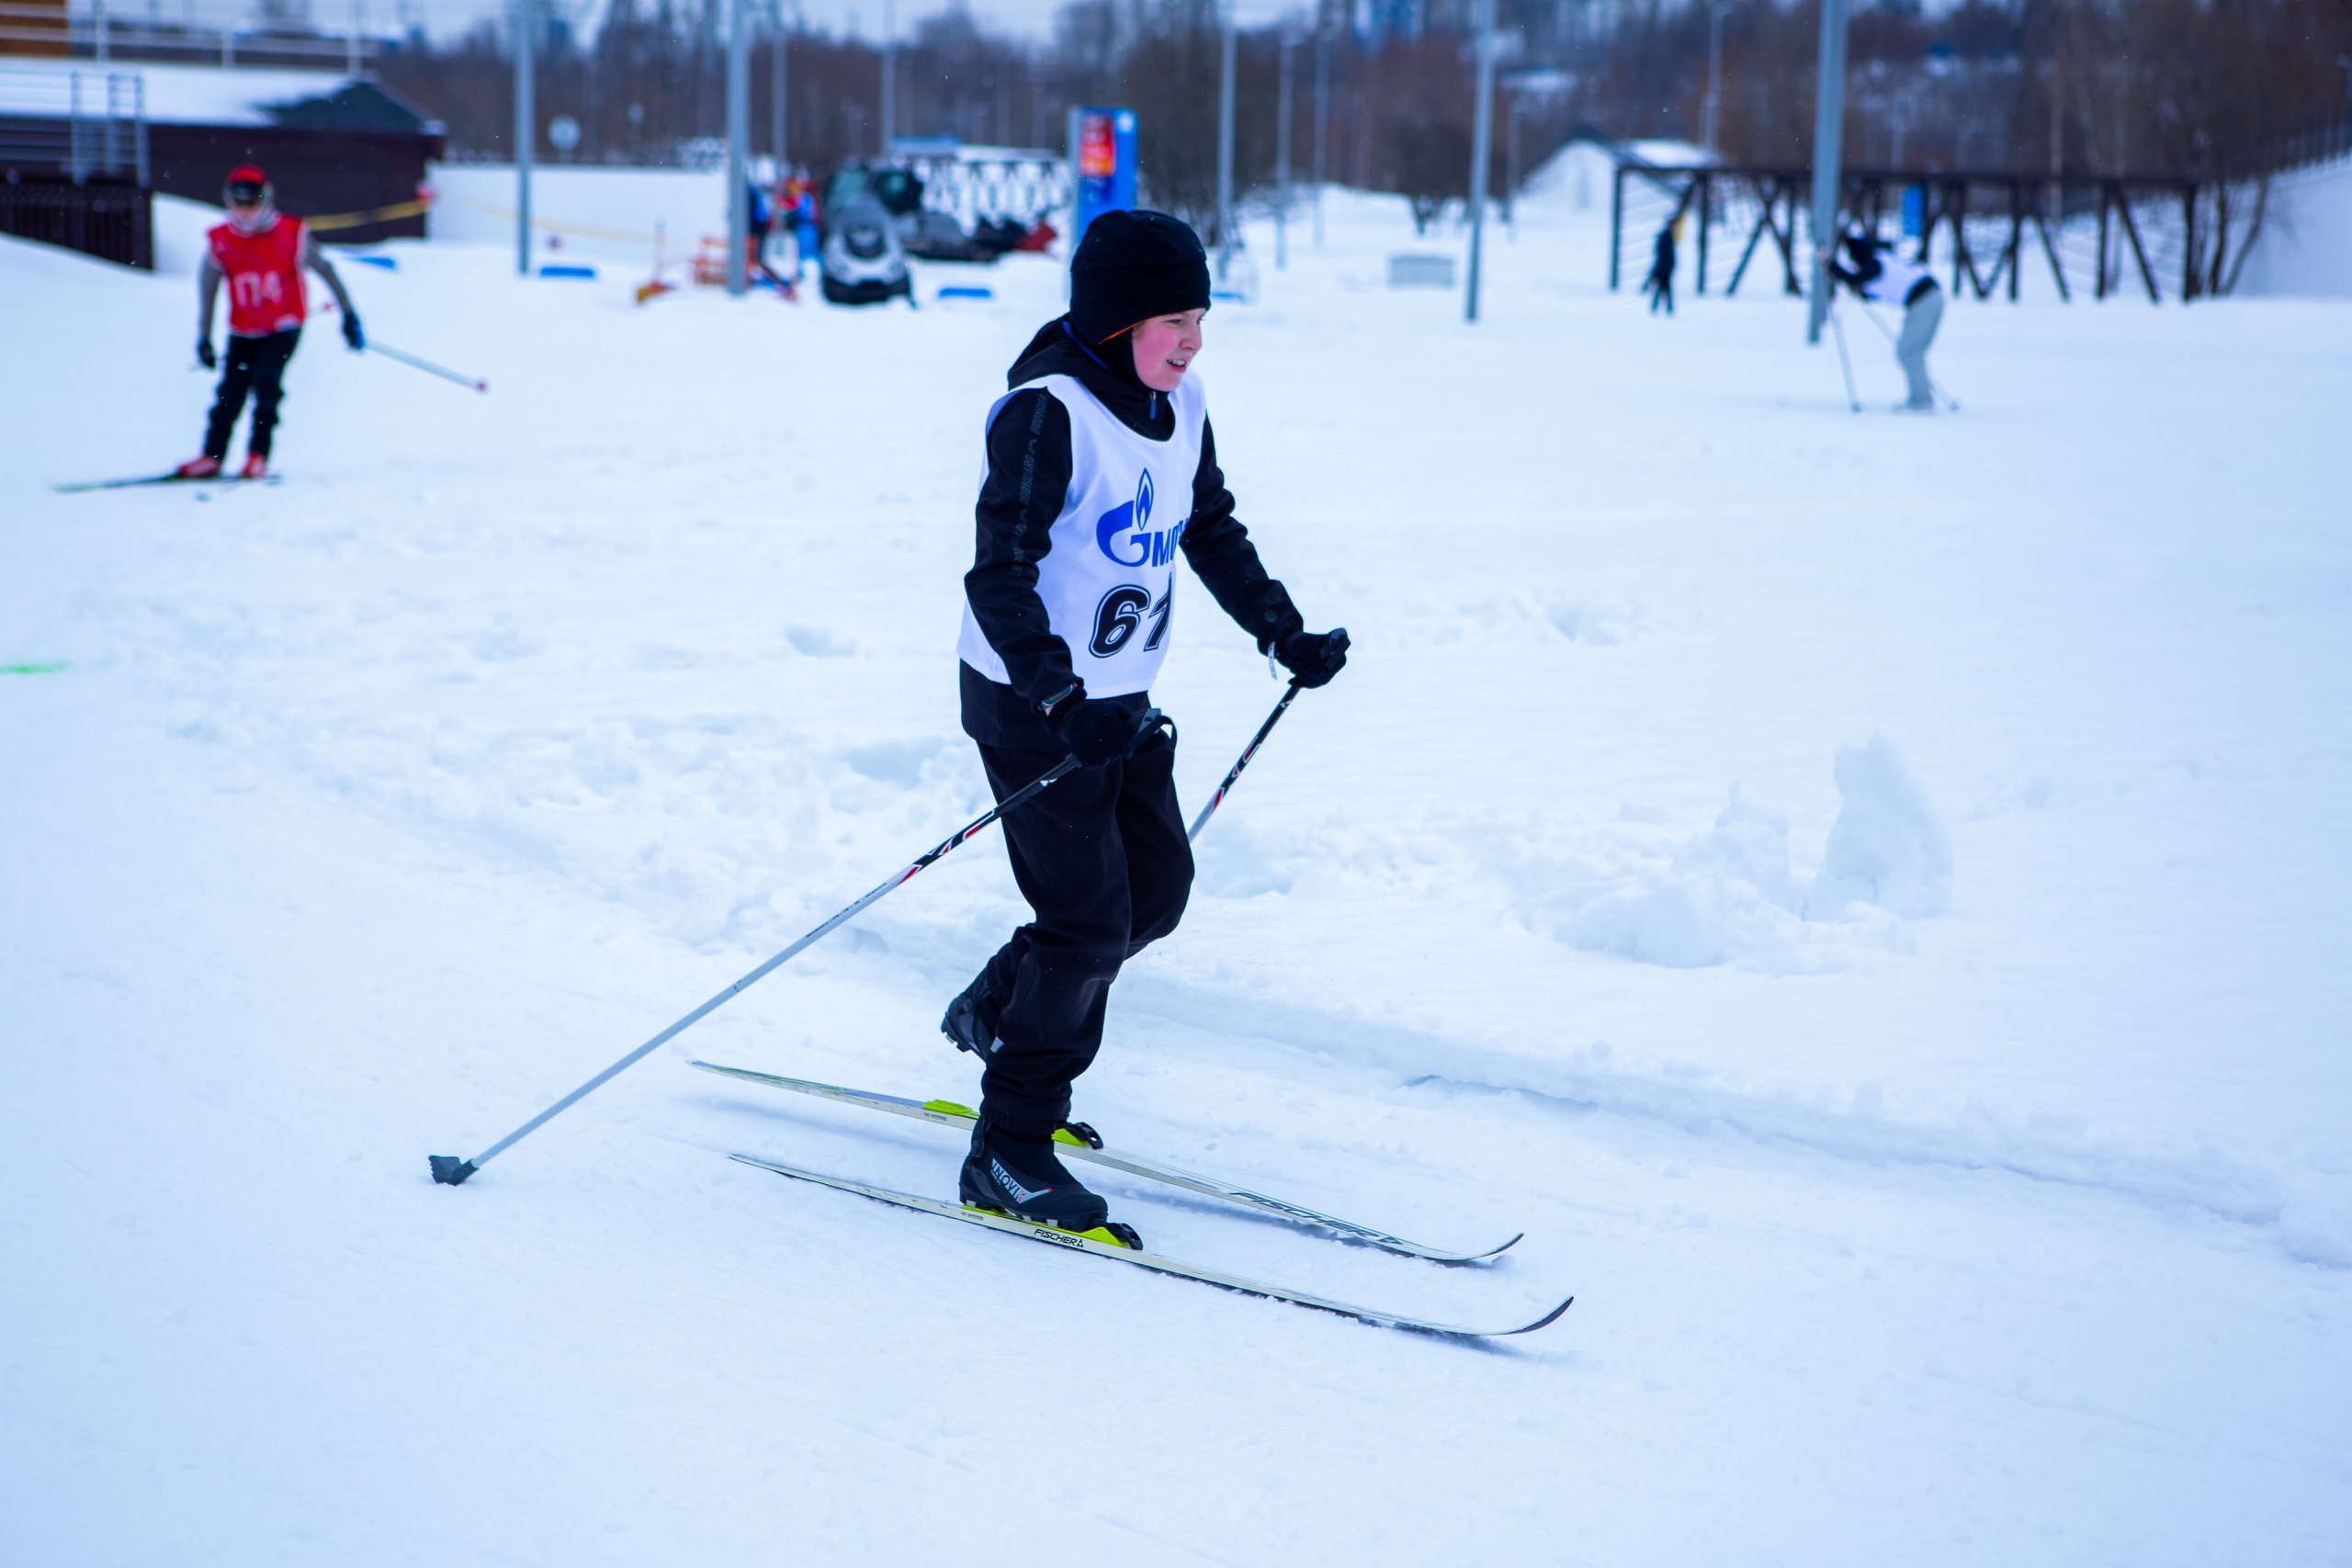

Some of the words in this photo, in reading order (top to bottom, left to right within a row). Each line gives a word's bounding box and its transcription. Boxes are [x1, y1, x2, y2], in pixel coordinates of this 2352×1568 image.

[1017, 454, 1035, 506] BODYGUARD
[1030, 393, 1048, 435] BODYGUA
[1089, 571, 1173, 660] 61
[992, 1161, 1026, 1204] INOVIK
[1034, 1228, 1077, 1247] FISCHER
